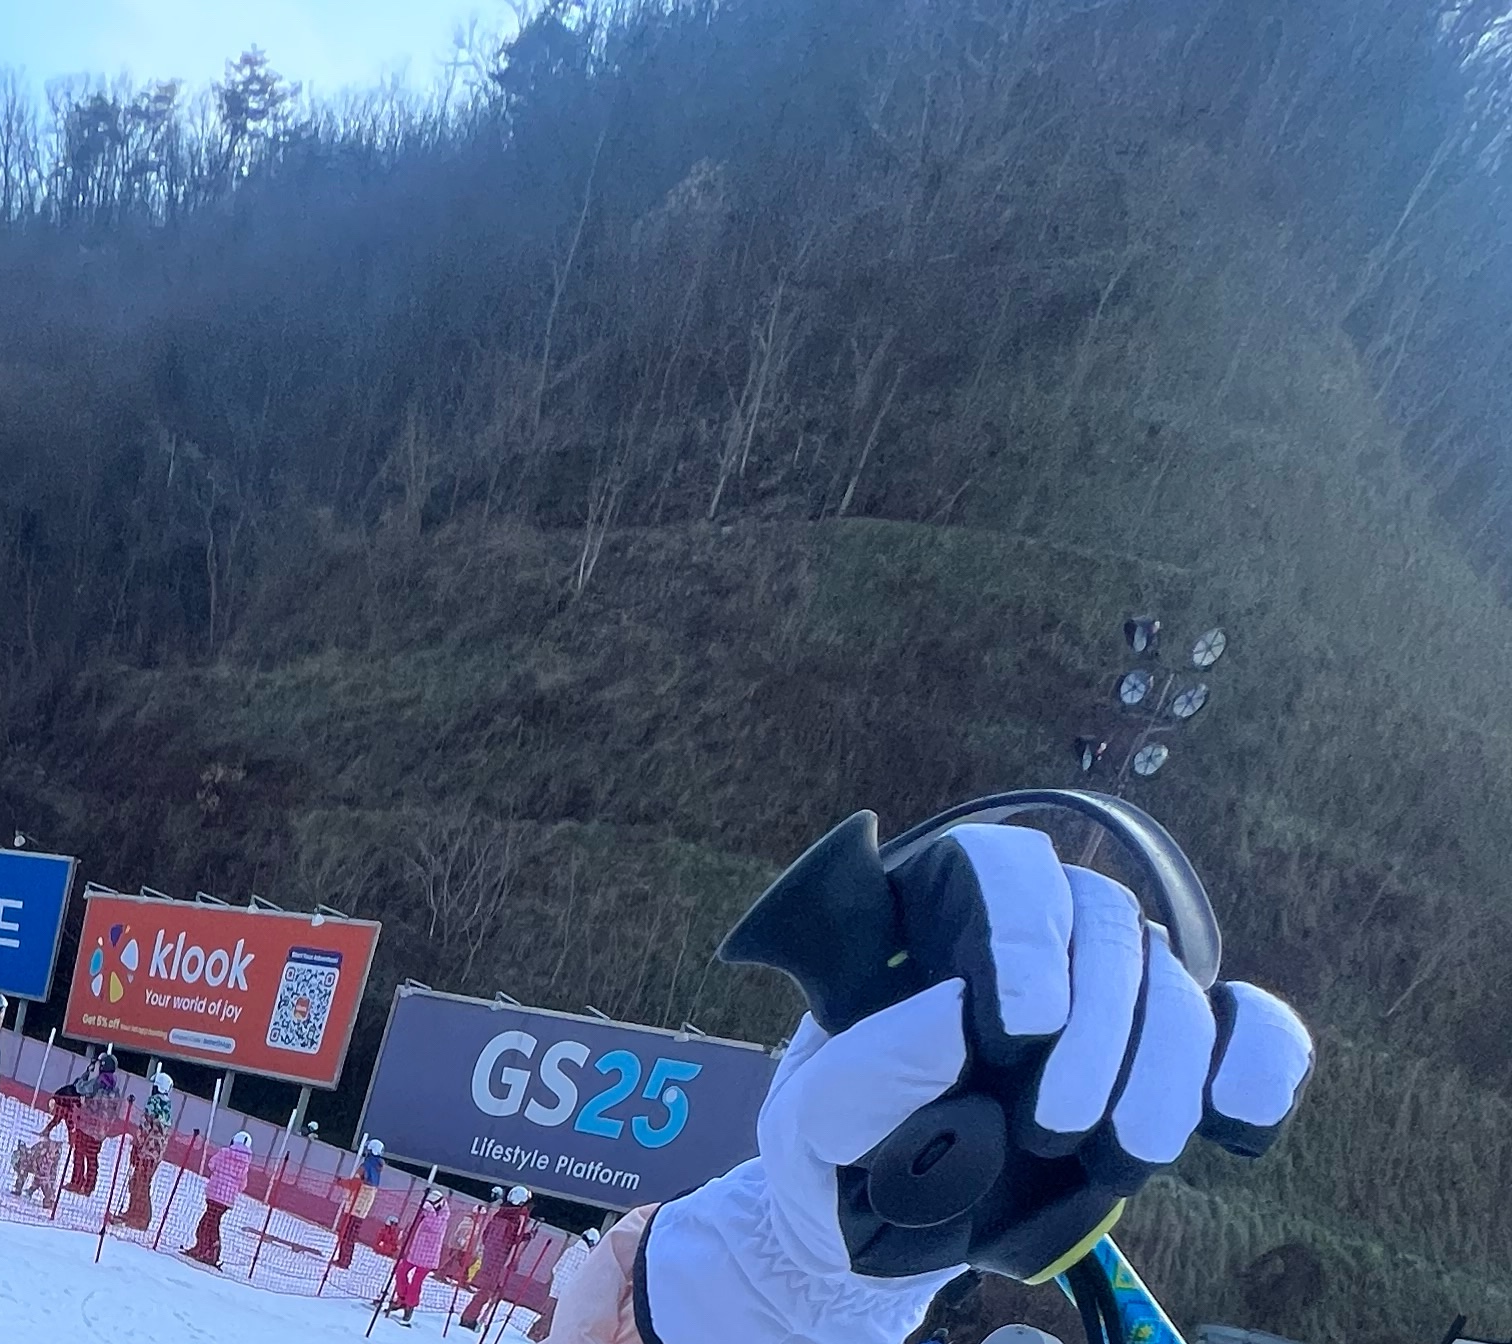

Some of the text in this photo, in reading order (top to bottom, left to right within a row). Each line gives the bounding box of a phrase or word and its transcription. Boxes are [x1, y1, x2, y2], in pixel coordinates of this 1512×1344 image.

[149, 929, 255, 991] klook
[145, 988, 243, 1023] Your world of joy
[471, 1030, 703, 1149] GS25
[471, 1136, 641, 1191] Lifestyle Platform
